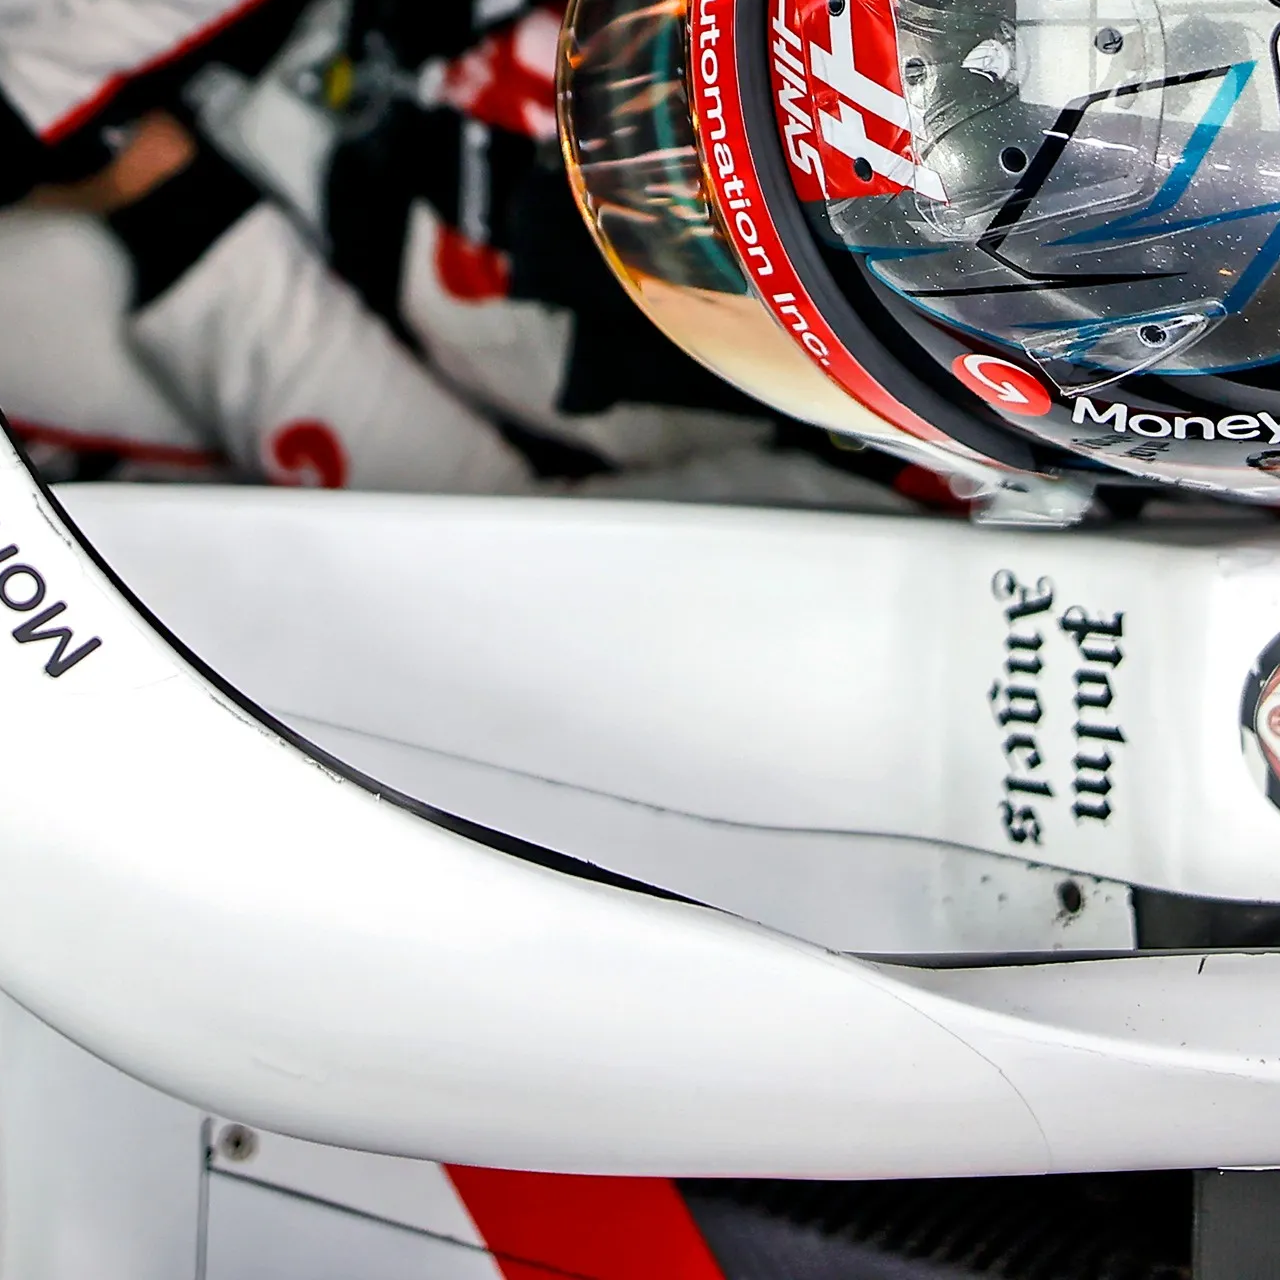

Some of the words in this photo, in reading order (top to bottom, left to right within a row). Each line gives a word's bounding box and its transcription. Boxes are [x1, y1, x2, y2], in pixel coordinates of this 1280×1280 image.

[770, 288, 834, 368] Inc.
[990, 568, 1055, 847] Angels
[1058, 603, 1127, 829] Palm
